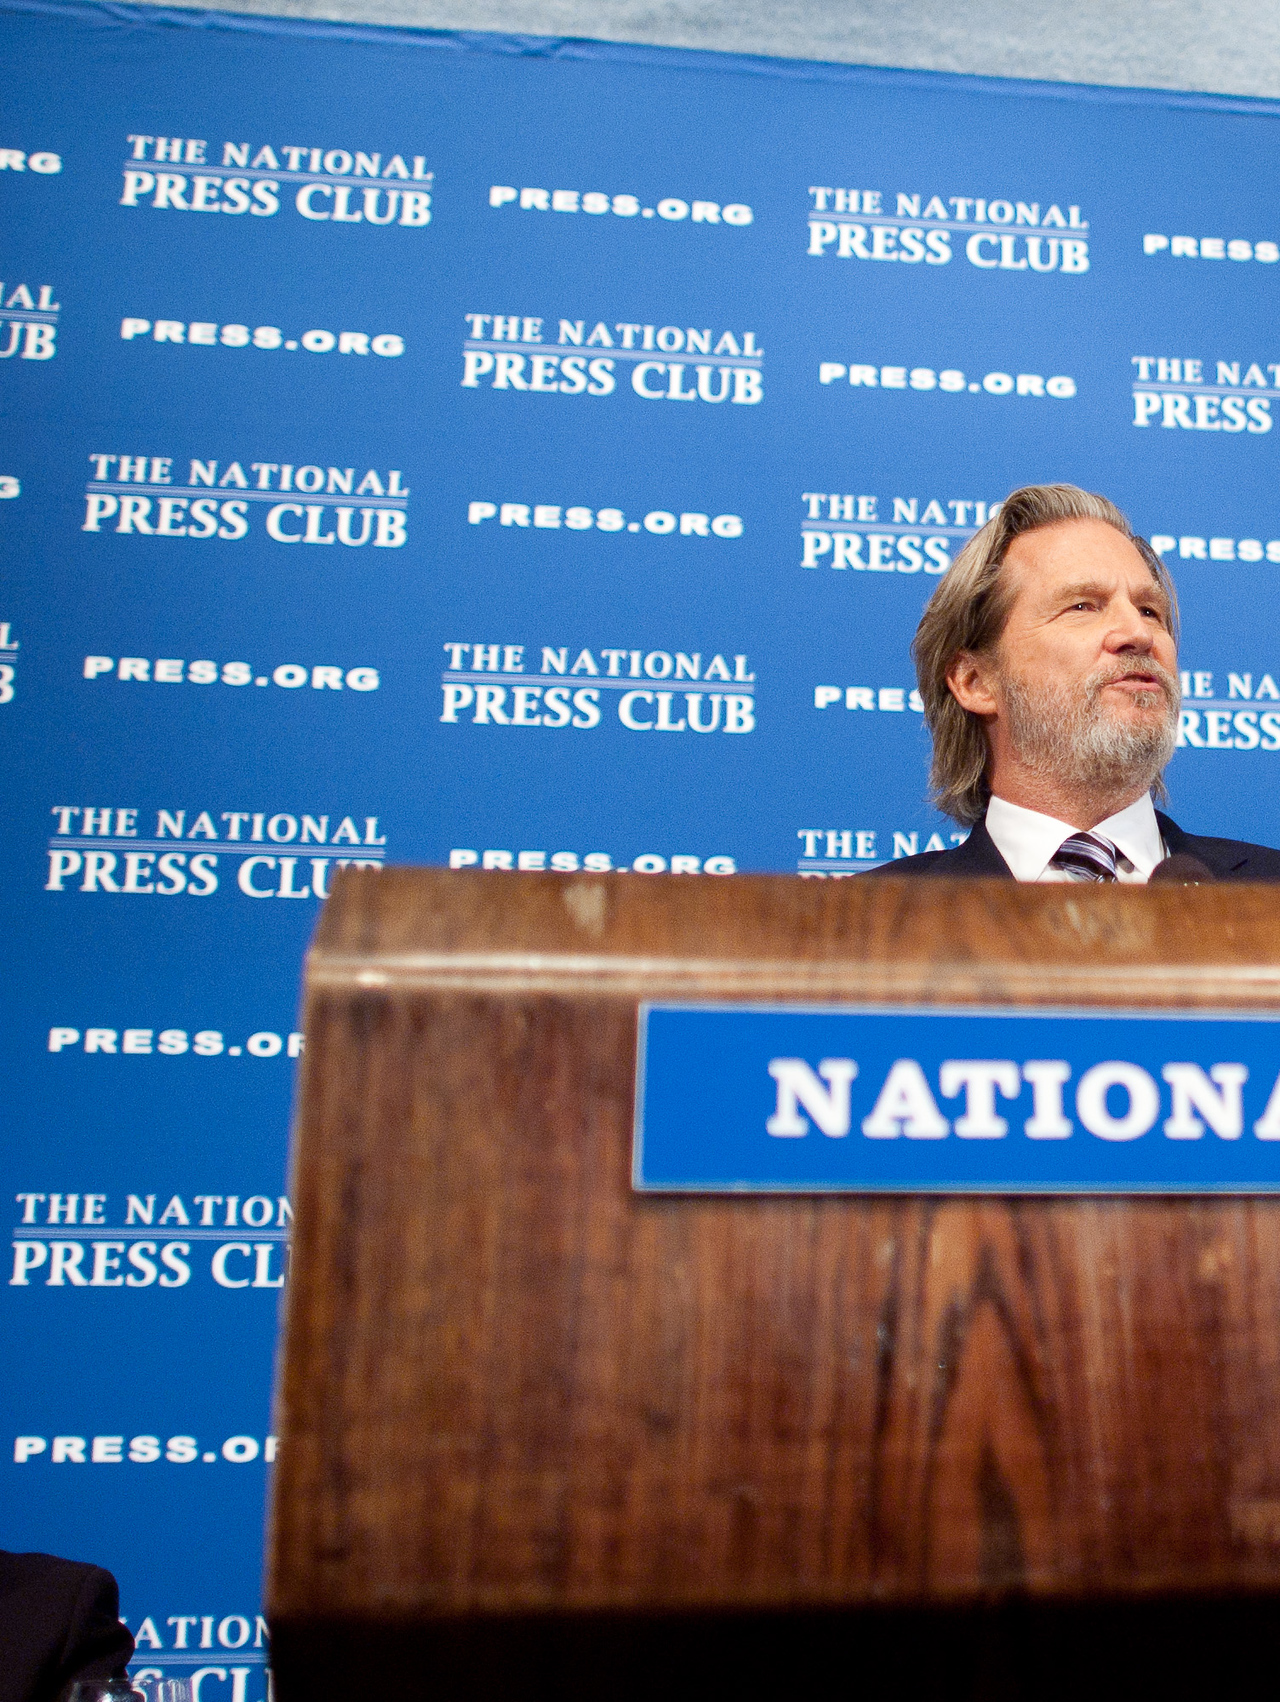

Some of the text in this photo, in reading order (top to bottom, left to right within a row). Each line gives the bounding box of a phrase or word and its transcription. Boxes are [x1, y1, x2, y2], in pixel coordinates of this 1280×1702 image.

[128, 135, 433, 180] THE NATIONAL
[121, 170, 430, 226] PRESS CLUB
[489, 186, 752, 225] PRESS.ORG
[809, 187, 1088, 229] THE NATIONAL
[808, 221, 1089, 272] PRESS CLUB
[121, 318, 404, 356] PRESS.ORG
[465, 314, 763, 357] THE NATIONAL
[462, 351, 762, 404] PRESS CLUB
[819, 363, 1076, 397] PRESS.ORG
[1132, 357, 1202, 383] THE
[1133, 392, 1272, 432] PRESS
[89, 454, 409, 497] THE NATIONAL
[83, 493, 406, 547] PRESS CLUB
[468, 502, 742, 537] PRESS.ORG
[802, 493, 877, 521] THE
[801, 531, 950, 574] PRESS
[83, 656, 379, 691] PRESS.ORG
[443, 643, 754, 681] THE NATIONAL
[440, 683, 754, 733] PRESS CLUB
[52, 806, 386, 845] THE NATIONAL
[797, 830, 876, 858] THE
[893, 832, 968, 859] NAT
[46, 850, 384, 899] PRESS CLU
[449, 850, 736, 877] PRESS.ORG
[16, 1194, 106, 1224] THE
[9, 1241, 190, 1288] PRESS
[14, 1436, 280, 1463] PRESS.O
